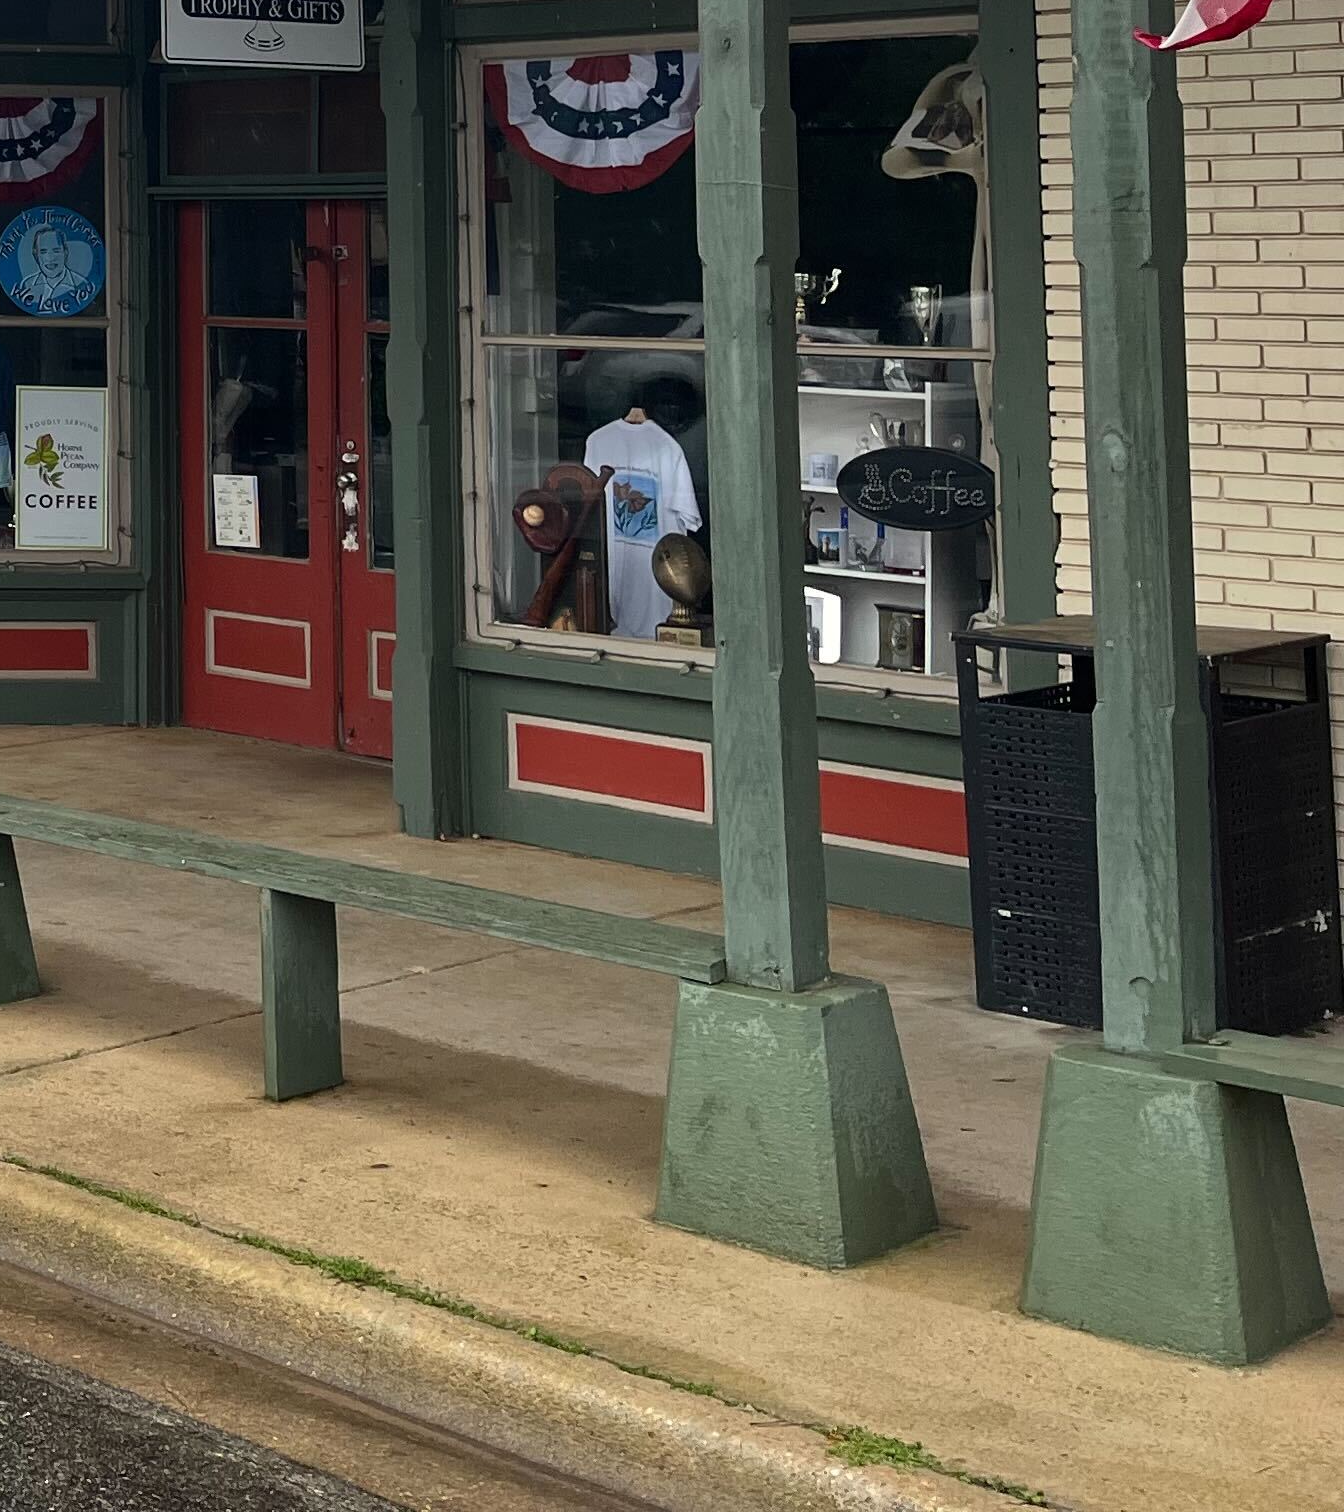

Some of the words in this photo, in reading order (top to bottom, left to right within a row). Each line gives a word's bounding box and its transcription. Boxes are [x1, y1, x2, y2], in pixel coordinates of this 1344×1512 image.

[268, 0, 283, 18] &
[11, 282, 34, 305] We
[37, 294, 70, 314] Love
[70, 281, 96, 305] You
[24, 419, 60, 431] PROUDLY
[65, 419, 99, 432] SERVING
[889, 468, 987, 514] Coffee
[25, 494, 97, 509] COFFEE
